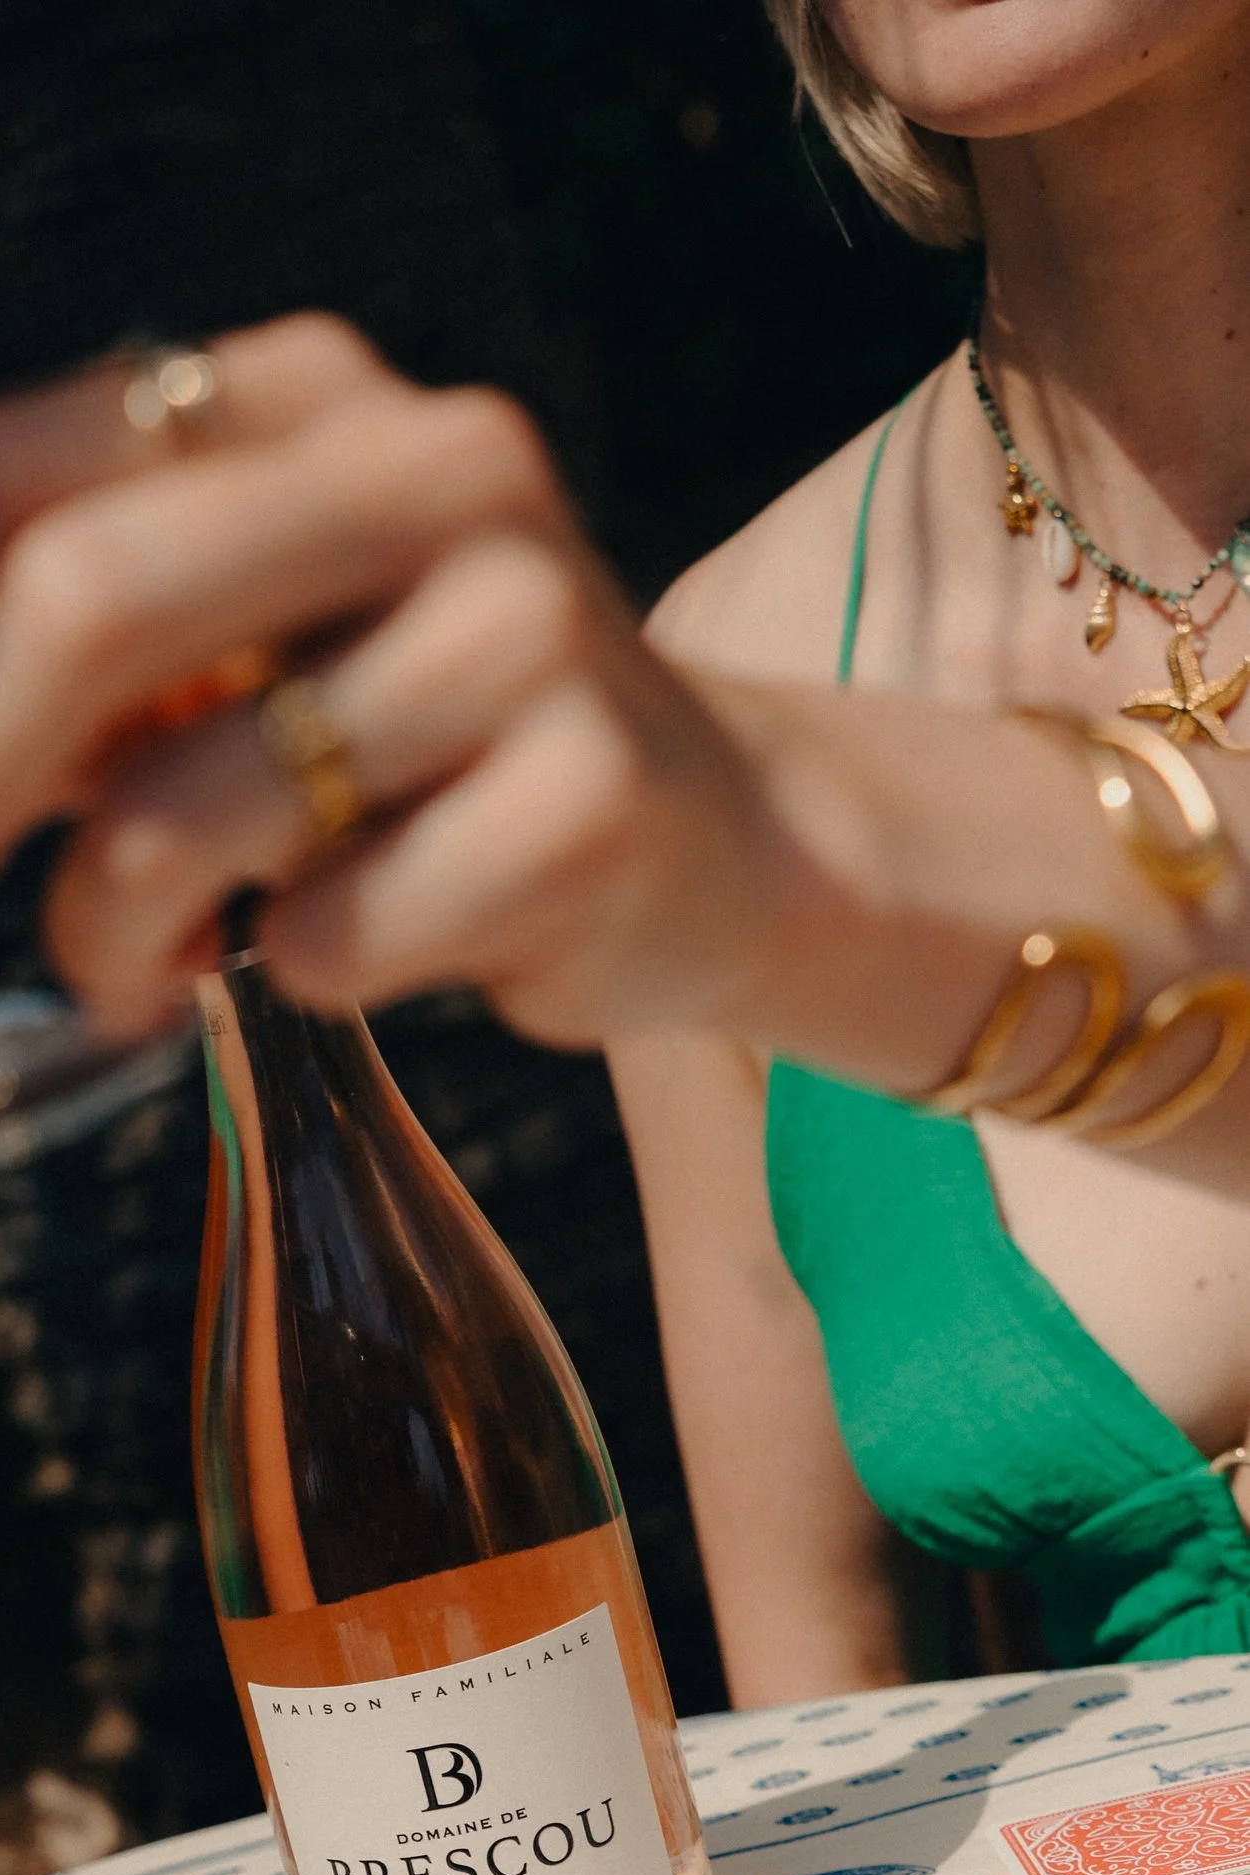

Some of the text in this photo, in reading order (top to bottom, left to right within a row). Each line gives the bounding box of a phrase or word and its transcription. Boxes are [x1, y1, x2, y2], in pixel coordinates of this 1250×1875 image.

[272, 1632, 590, 1716] MAISON FAMILIALE
[396, 1807, 528, 1845] DOMAINE DE
